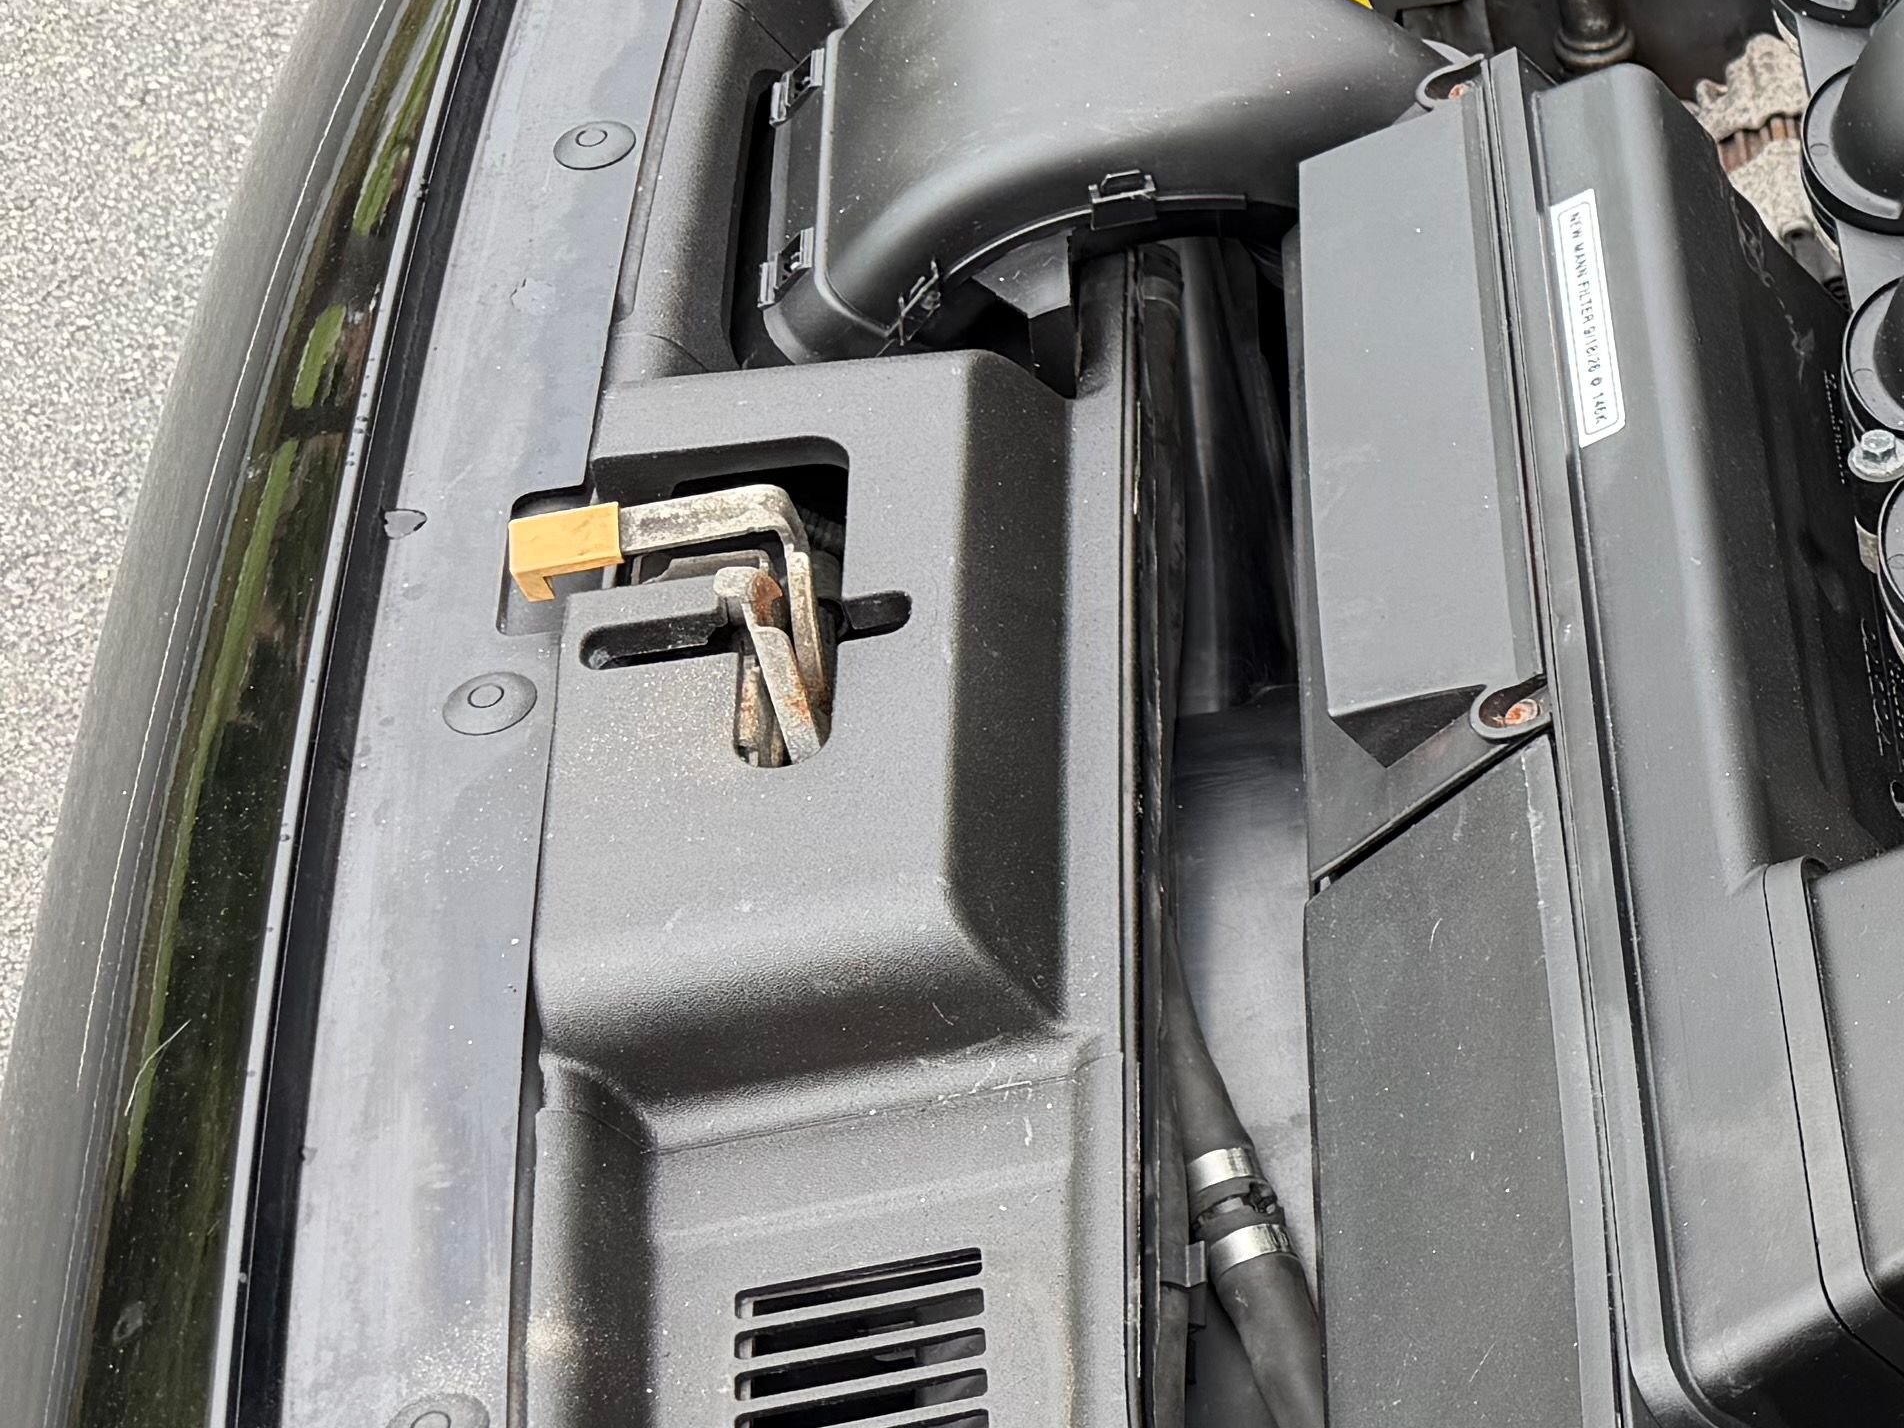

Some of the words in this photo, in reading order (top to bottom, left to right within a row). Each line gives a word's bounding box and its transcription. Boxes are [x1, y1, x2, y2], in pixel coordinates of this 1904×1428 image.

[1567, 212, 1583, 238] NEW
[1571, 243, 1588, 277] MANN
[1576, 281, 1594, 323] FILTER
